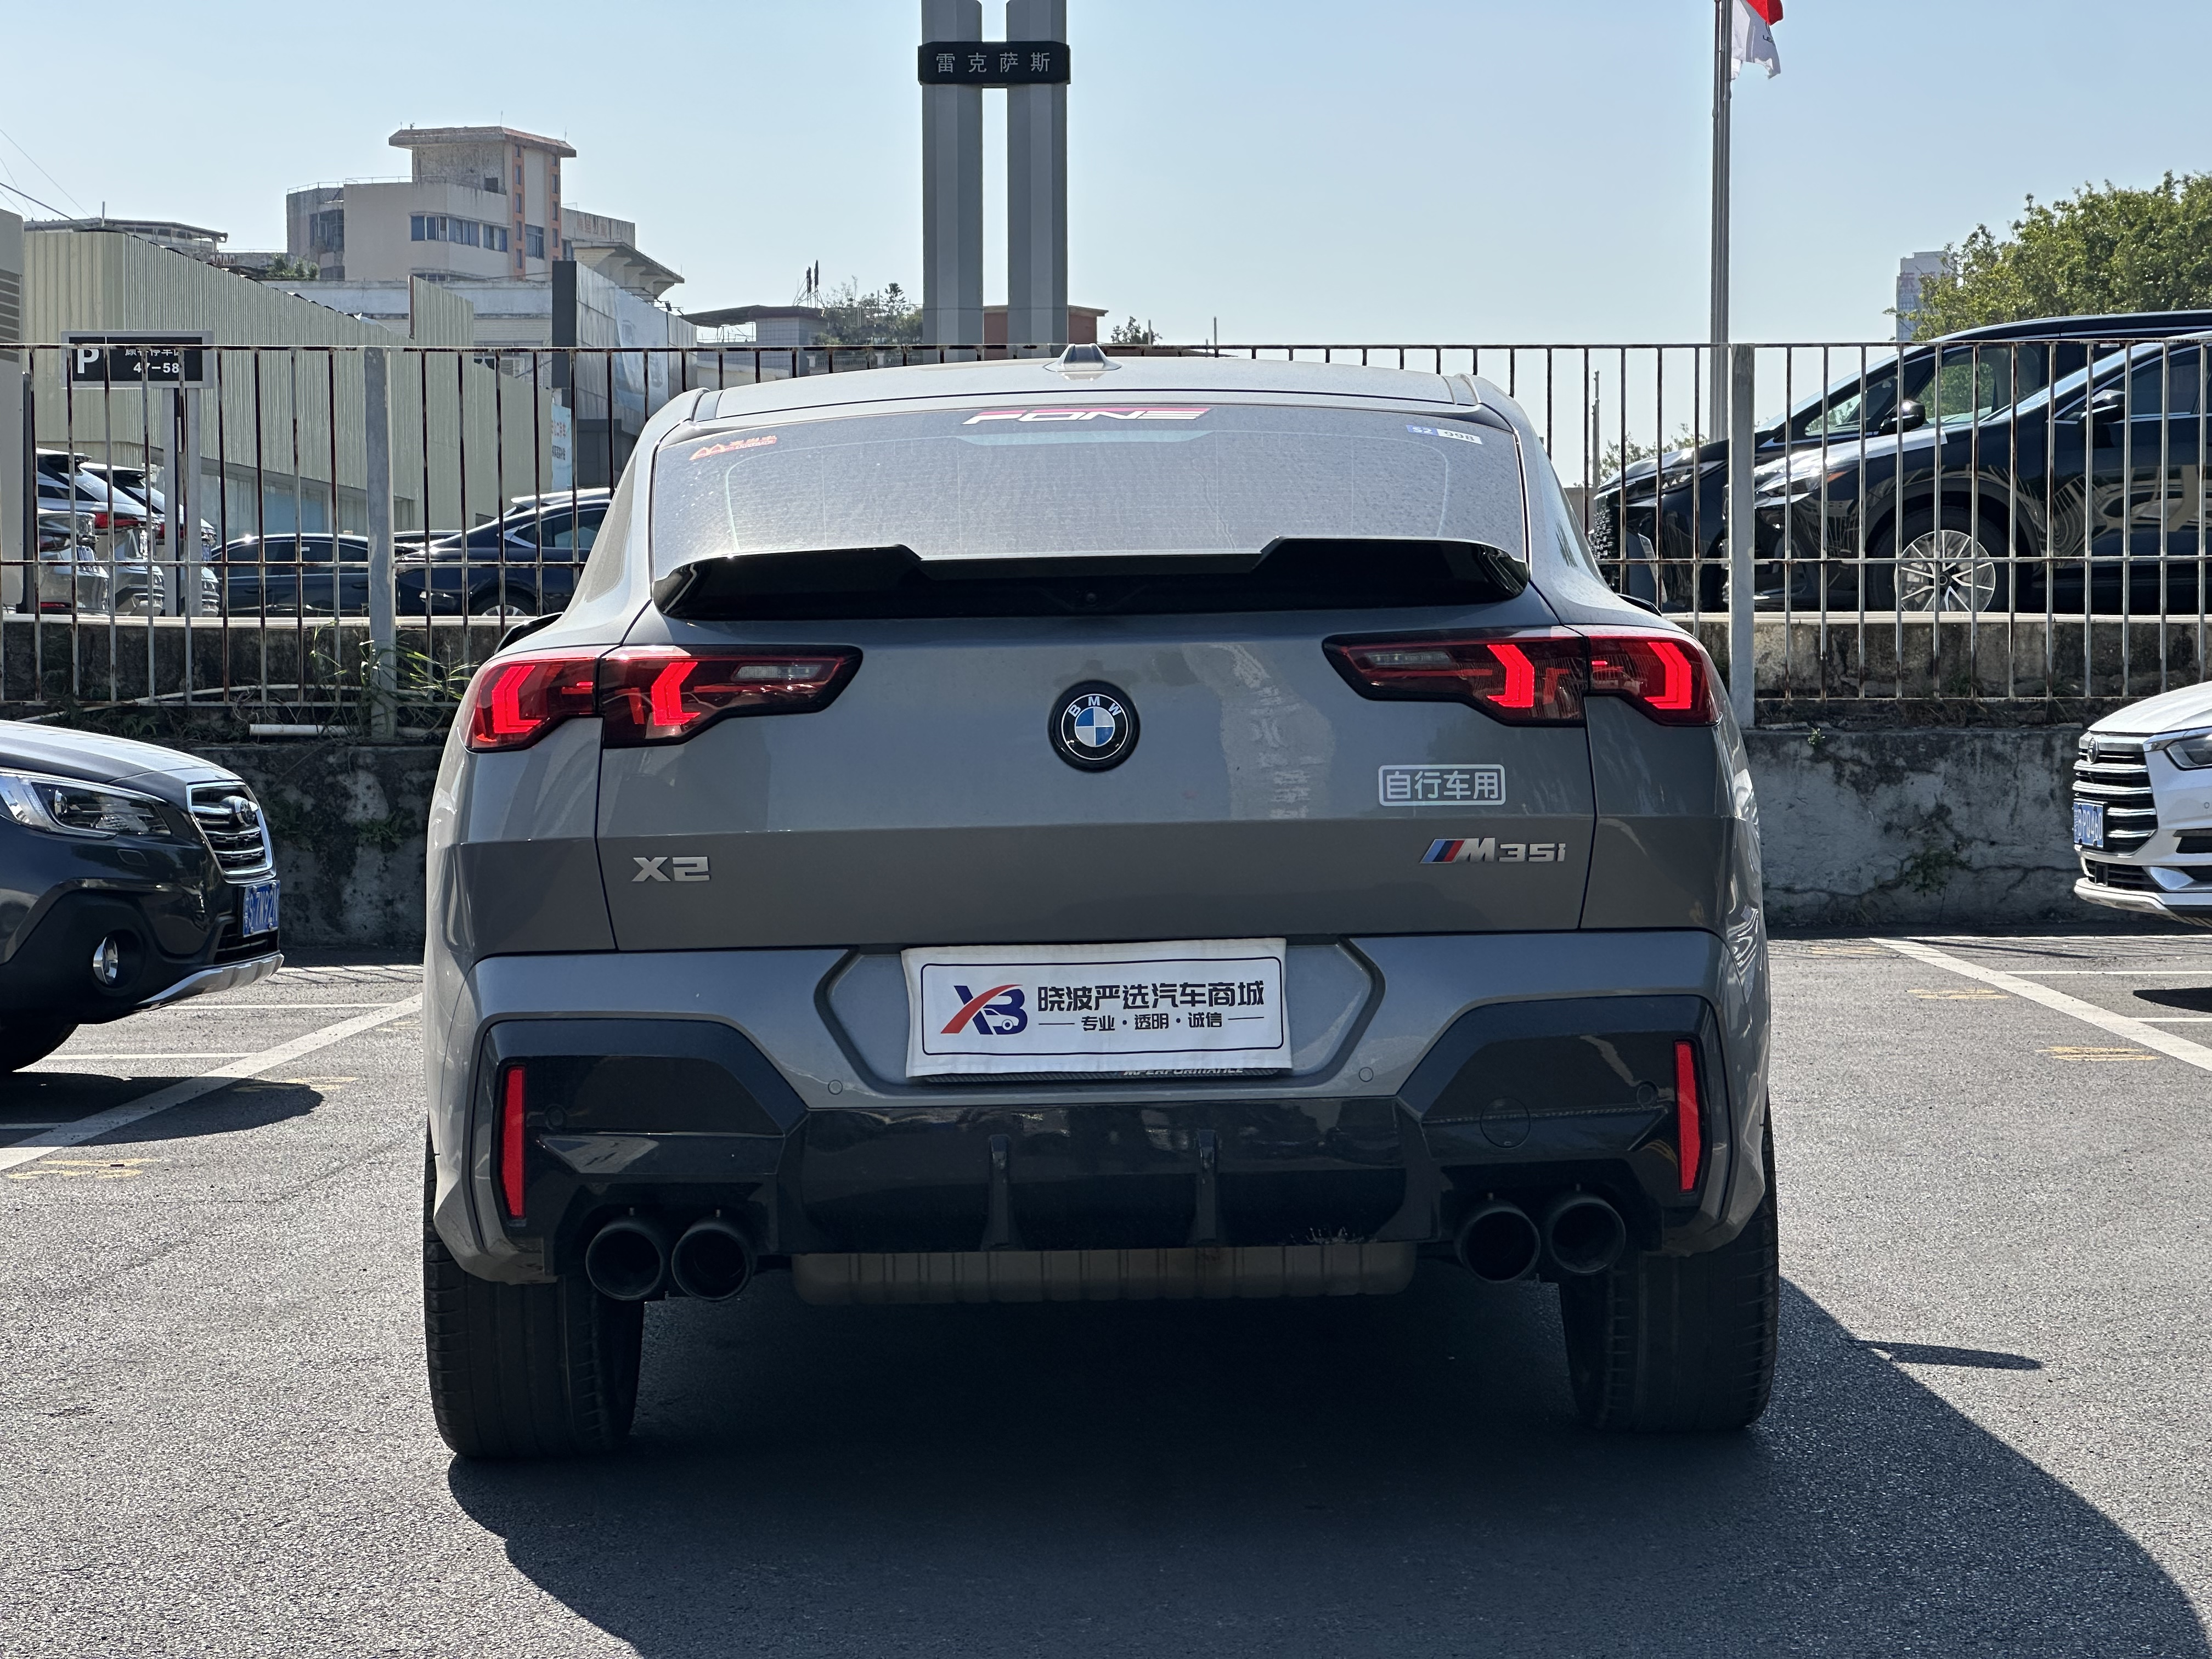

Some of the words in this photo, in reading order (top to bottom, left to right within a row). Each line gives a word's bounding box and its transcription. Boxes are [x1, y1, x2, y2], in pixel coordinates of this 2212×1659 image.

[936, 52, 1051, 73] 雷克萨斯
[77, 349, 99, 374] P
[1444, 431, 1475, 441] 998
[1068, 696, 1121, 717] BMW
[1386, 770, 1499, 799] 自行车用
[631, 856, 710, 882] X2
[1038, 980, 1265, 1012] 晓波严选汽车商城
